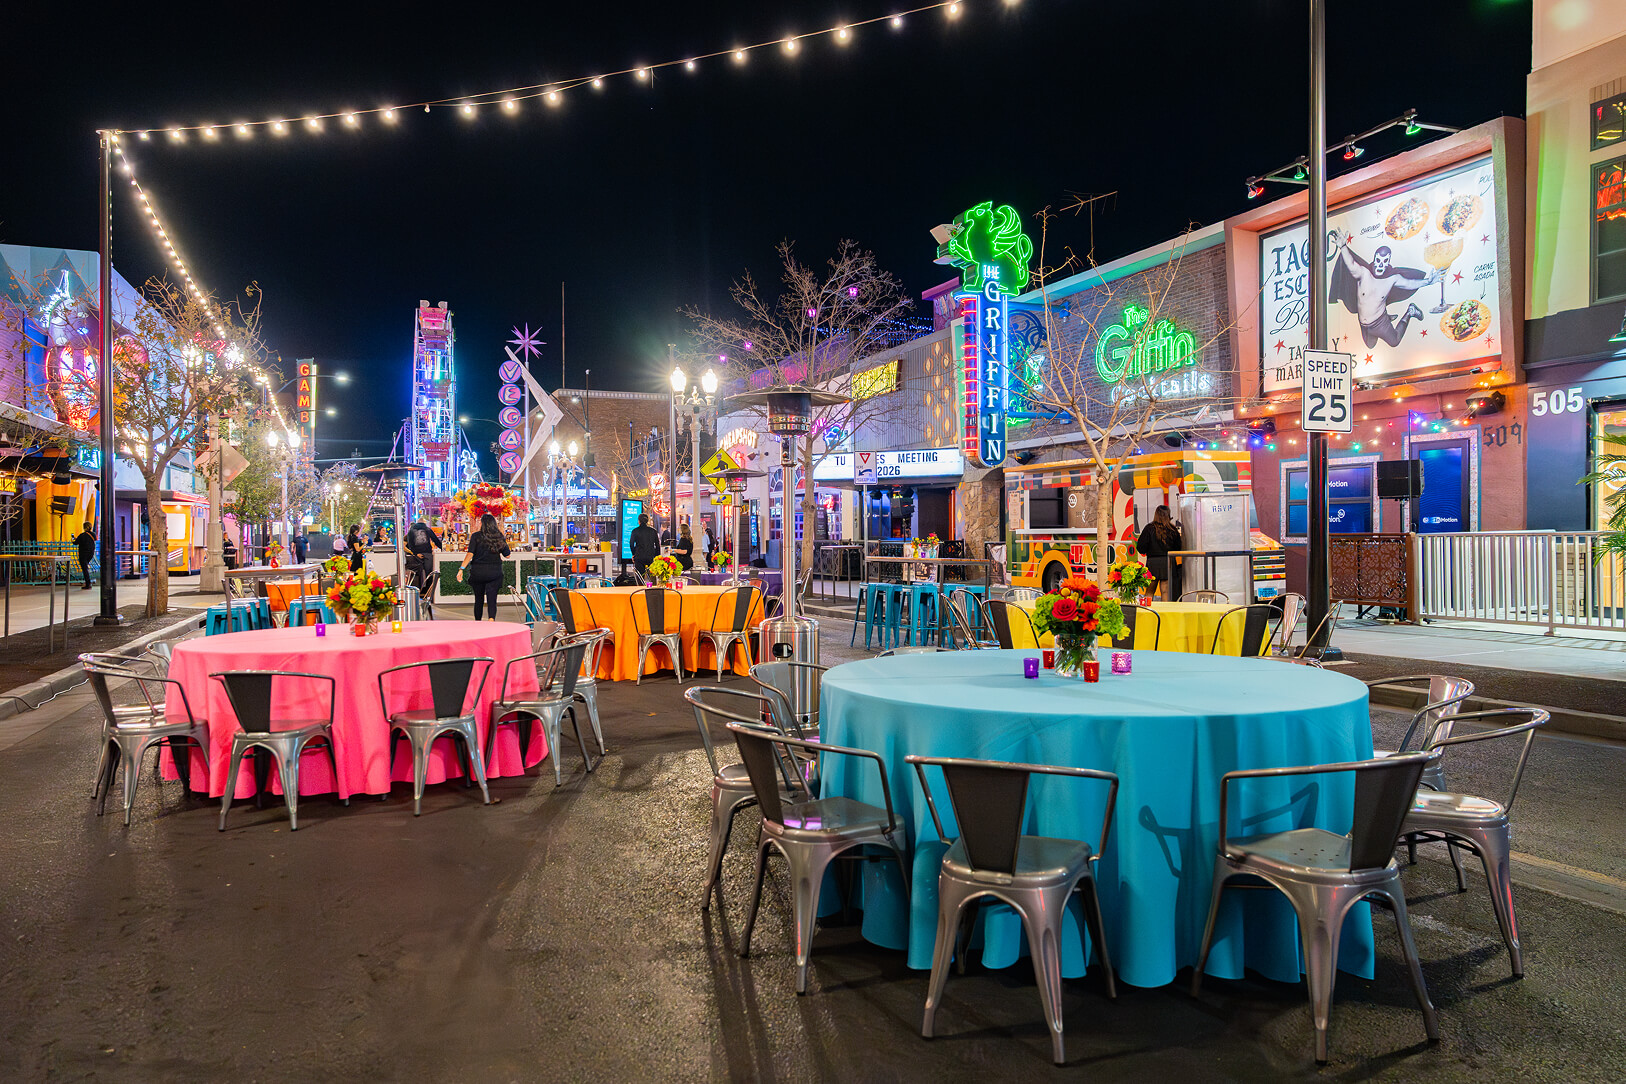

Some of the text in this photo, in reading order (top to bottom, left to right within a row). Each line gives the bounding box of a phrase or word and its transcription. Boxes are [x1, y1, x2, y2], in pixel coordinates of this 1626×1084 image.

[983, 264, 1000, 280] THE
[1473, 261, 1495, 273] CARNE
[1473, 270, 1495, 282] ASADA
[1274, 274, 1308, 301] ESC
[1123, 305, 1149, 328] The
[1095, 320, 1195, 383] Griffin
[984, 280, 1003, 461] GRIFFIN
[1308, 360, 1348, 374] SPEED
[1312, 376, 1344, 390] LIMIT
[1308, 393, 1348, 423] 25
[1532, 387, 1584, 417] 505
[501, 362, 521, 472] VEGAS
[1483, 422, 1521, 447] 509
[835, 455, 846, 466] TU
[897, 451, 938, 464] MEETING
[877, 465, 901, 476] 2026
[1328, 480, 1348, 488] Motion
[1212, 504, 1233, 513] RSVP
